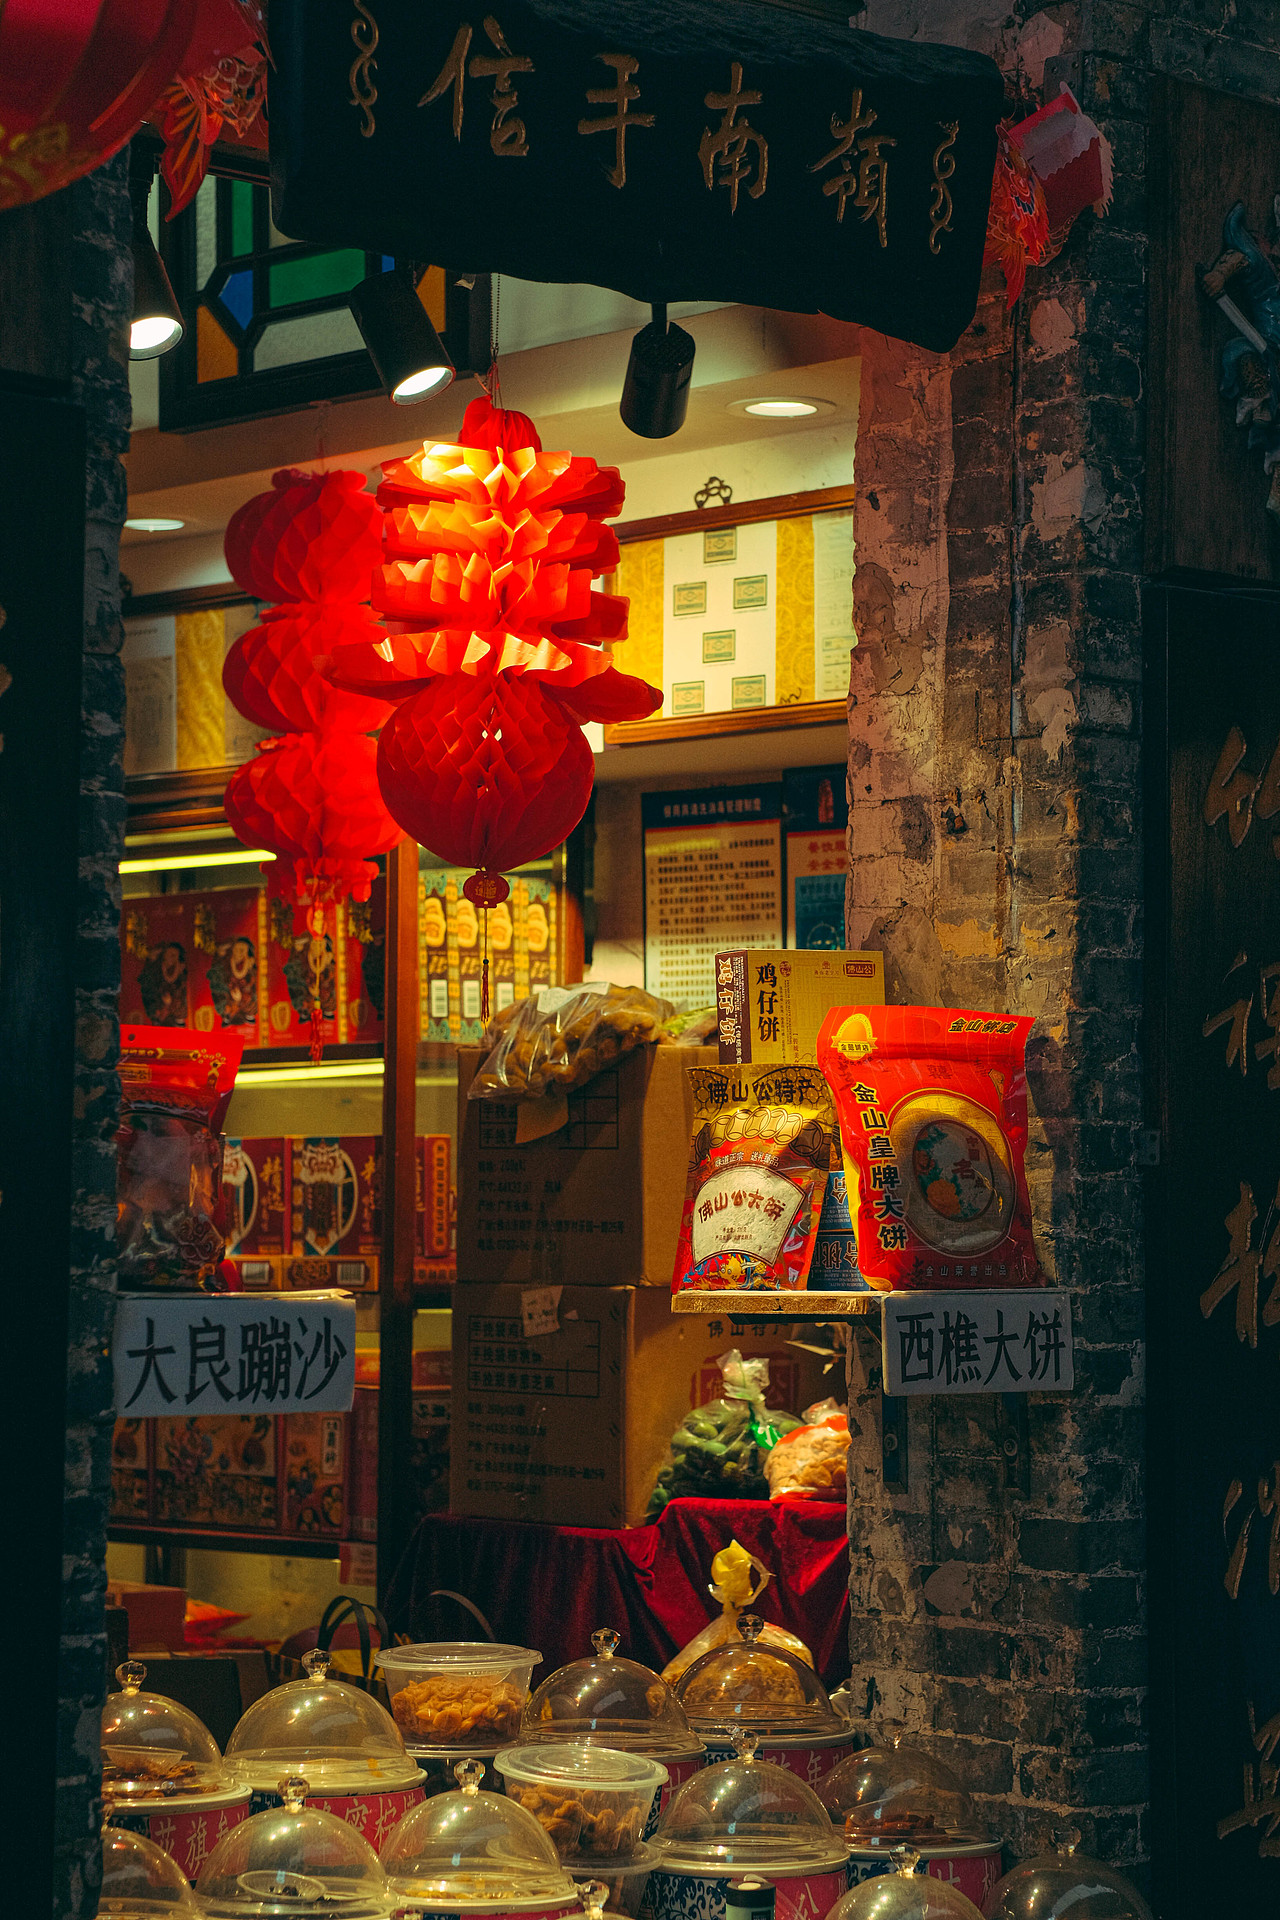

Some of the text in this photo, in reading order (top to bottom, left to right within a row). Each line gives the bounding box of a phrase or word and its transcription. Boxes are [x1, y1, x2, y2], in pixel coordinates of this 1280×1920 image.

[846, 963, 873, 976] 佛山公
[718, 957, 736, 1045] 鸡仔饼
[755, 962, 780, 1042] 鸡仔饼
[949, 1017, 1017, 1034] 金山饼店
[708, 1078, 816, 1104] 佛山公特产
[852, 1083, 907, 1250] 金山皇牌大饼
[698, 1189, 787, 1223] 佛山公大饼
[926, 1264, 1008, 1278] 金山荣誉出品
[124, 1315, 348, 1409] 大良蹦沙
[895, 1309, 1067, 1386] 西樵大饼
